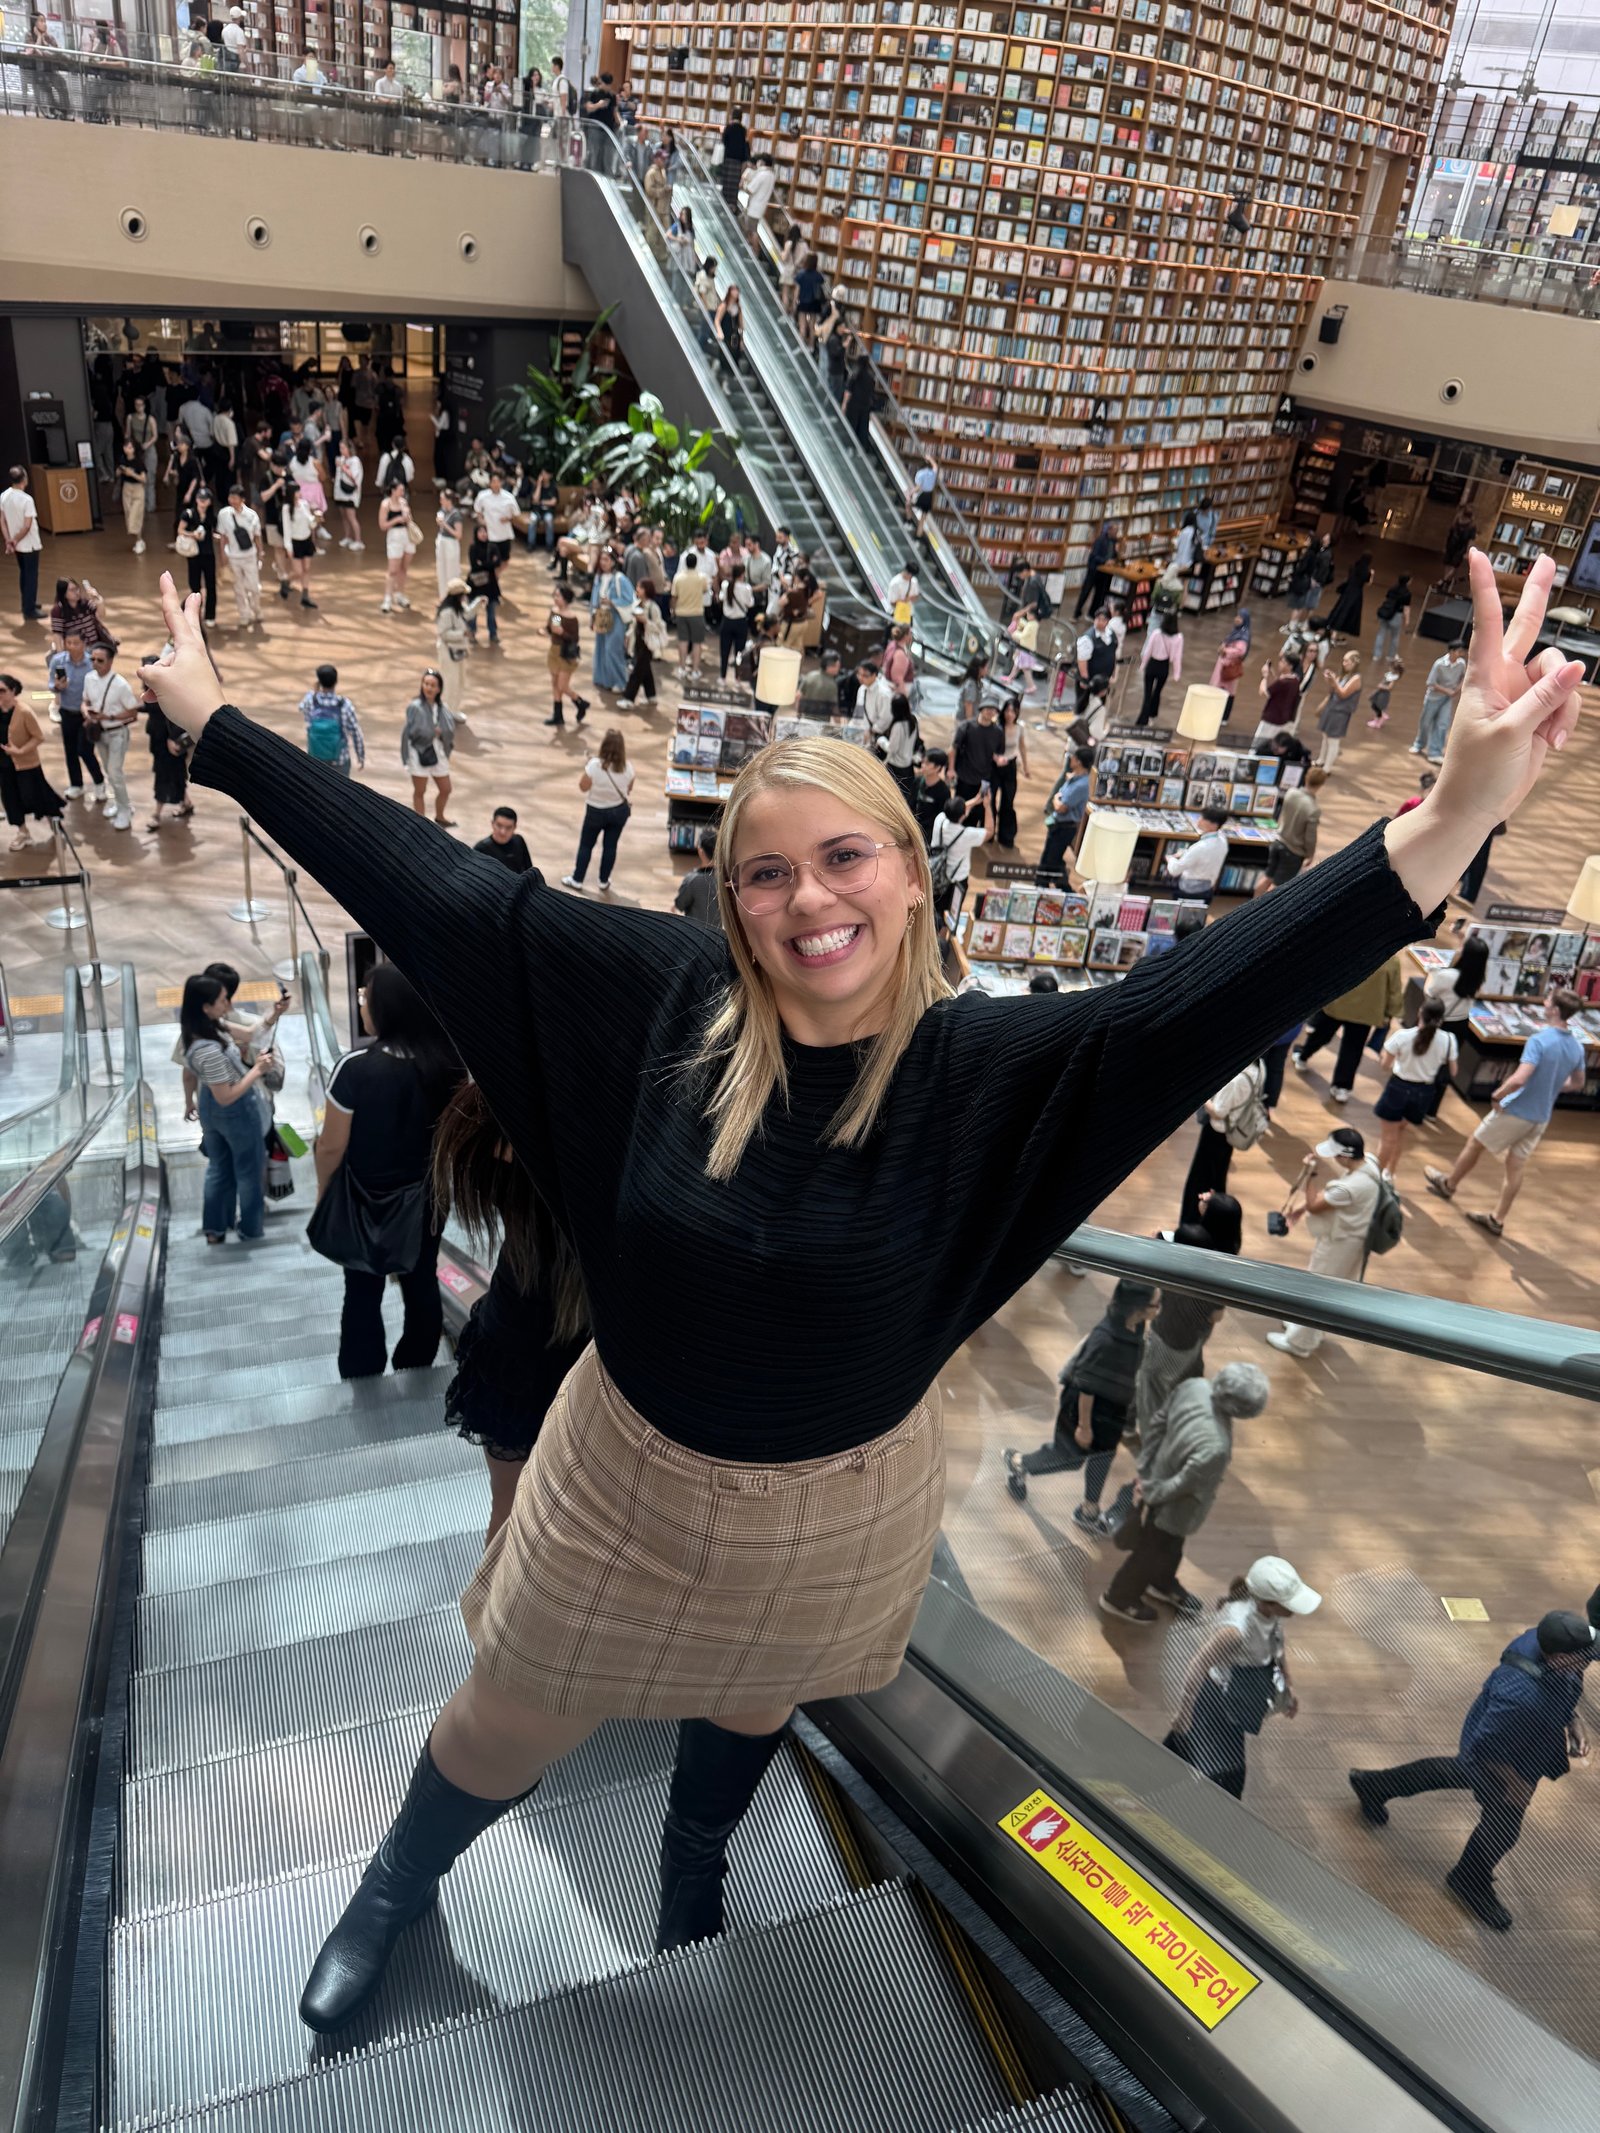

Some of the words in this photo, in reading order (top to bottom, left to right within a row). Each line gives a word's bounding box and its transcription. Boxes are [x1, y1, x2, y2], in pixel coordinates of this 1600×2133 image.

[1024, 1796, 1042, 1812] 안전
[1056, 1840, 1132, 1909] 손잡이를
[1122, 1900, 1154, 1926] 꼭
[1145, 1921, 1240, 2009] 잡으세요
